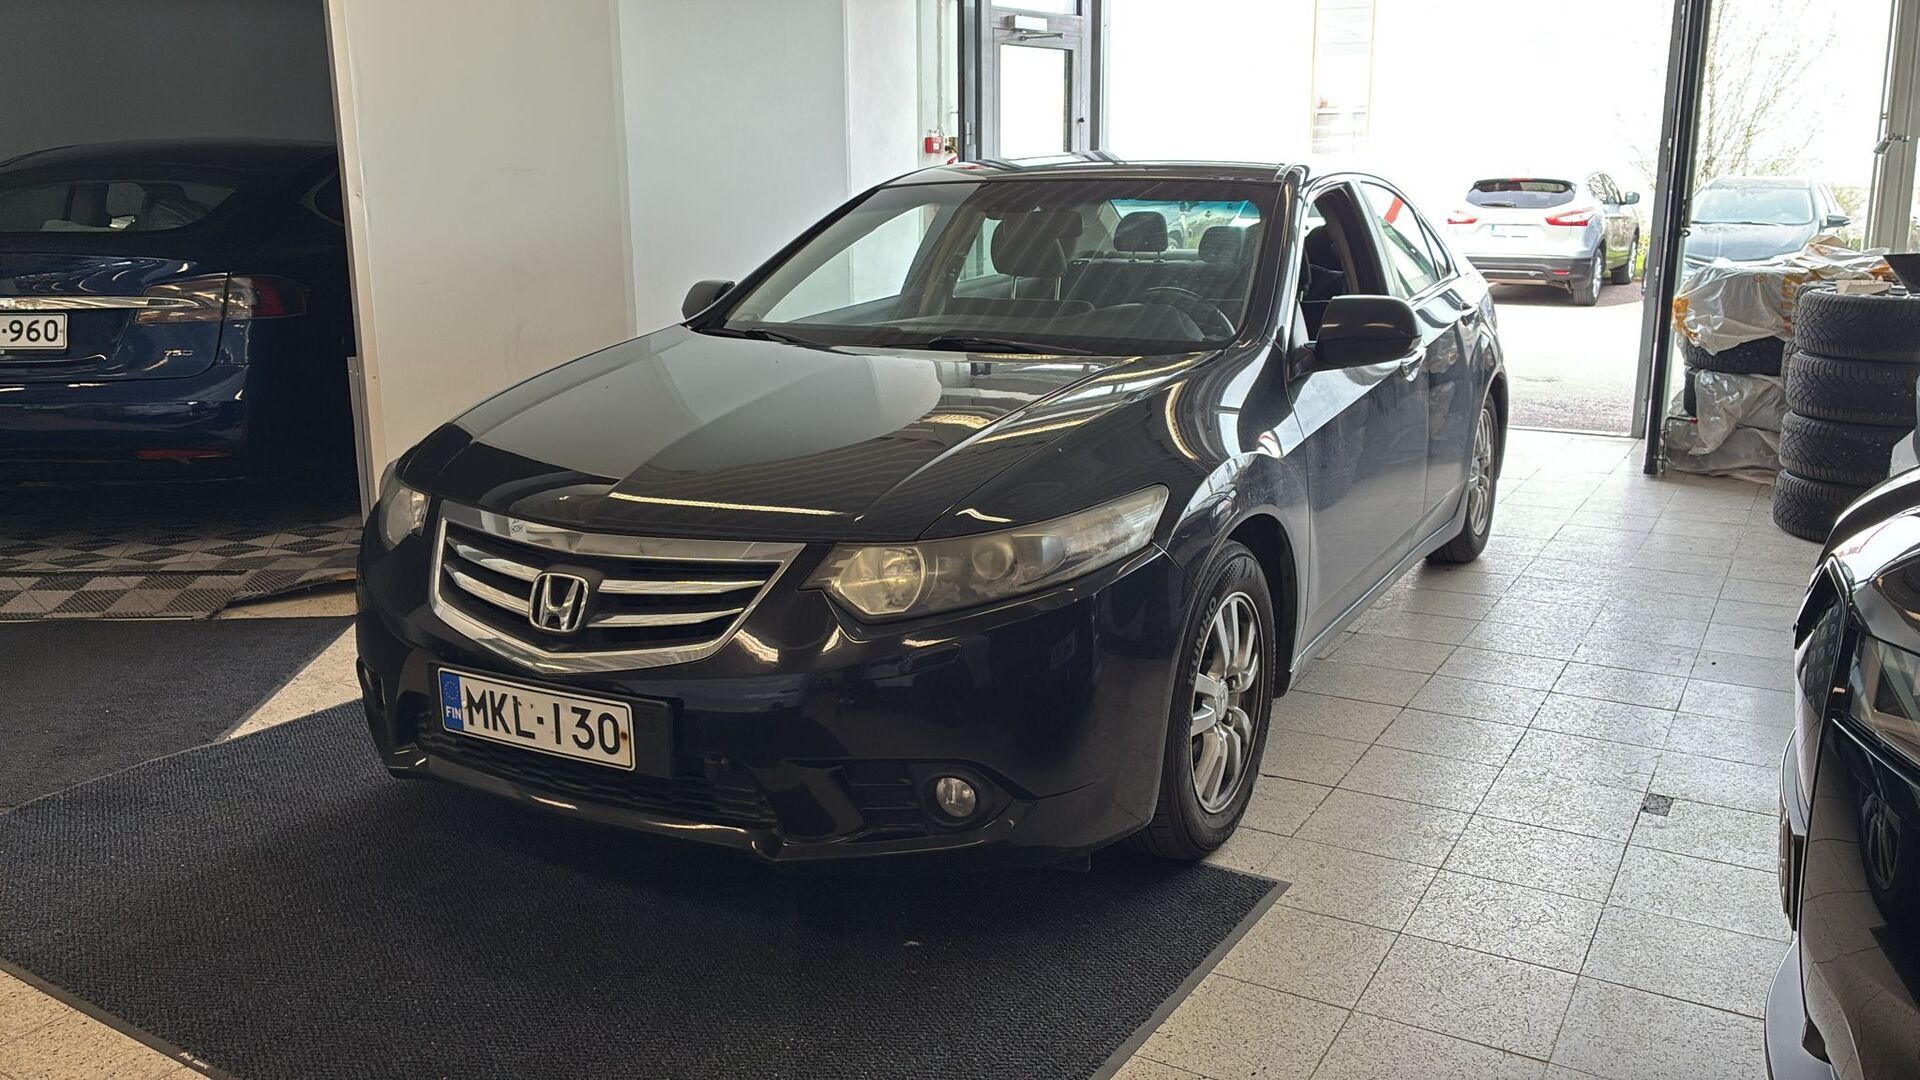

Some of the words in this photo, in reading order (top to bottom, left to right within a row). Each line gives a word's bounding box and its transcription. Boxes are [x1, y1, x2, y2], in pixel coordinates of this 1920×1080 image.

[1187, 595, 1217, 686] KUMHO
[445, 705, 462, 720] FIN
[465, 684, 621, 755] MKL-130
